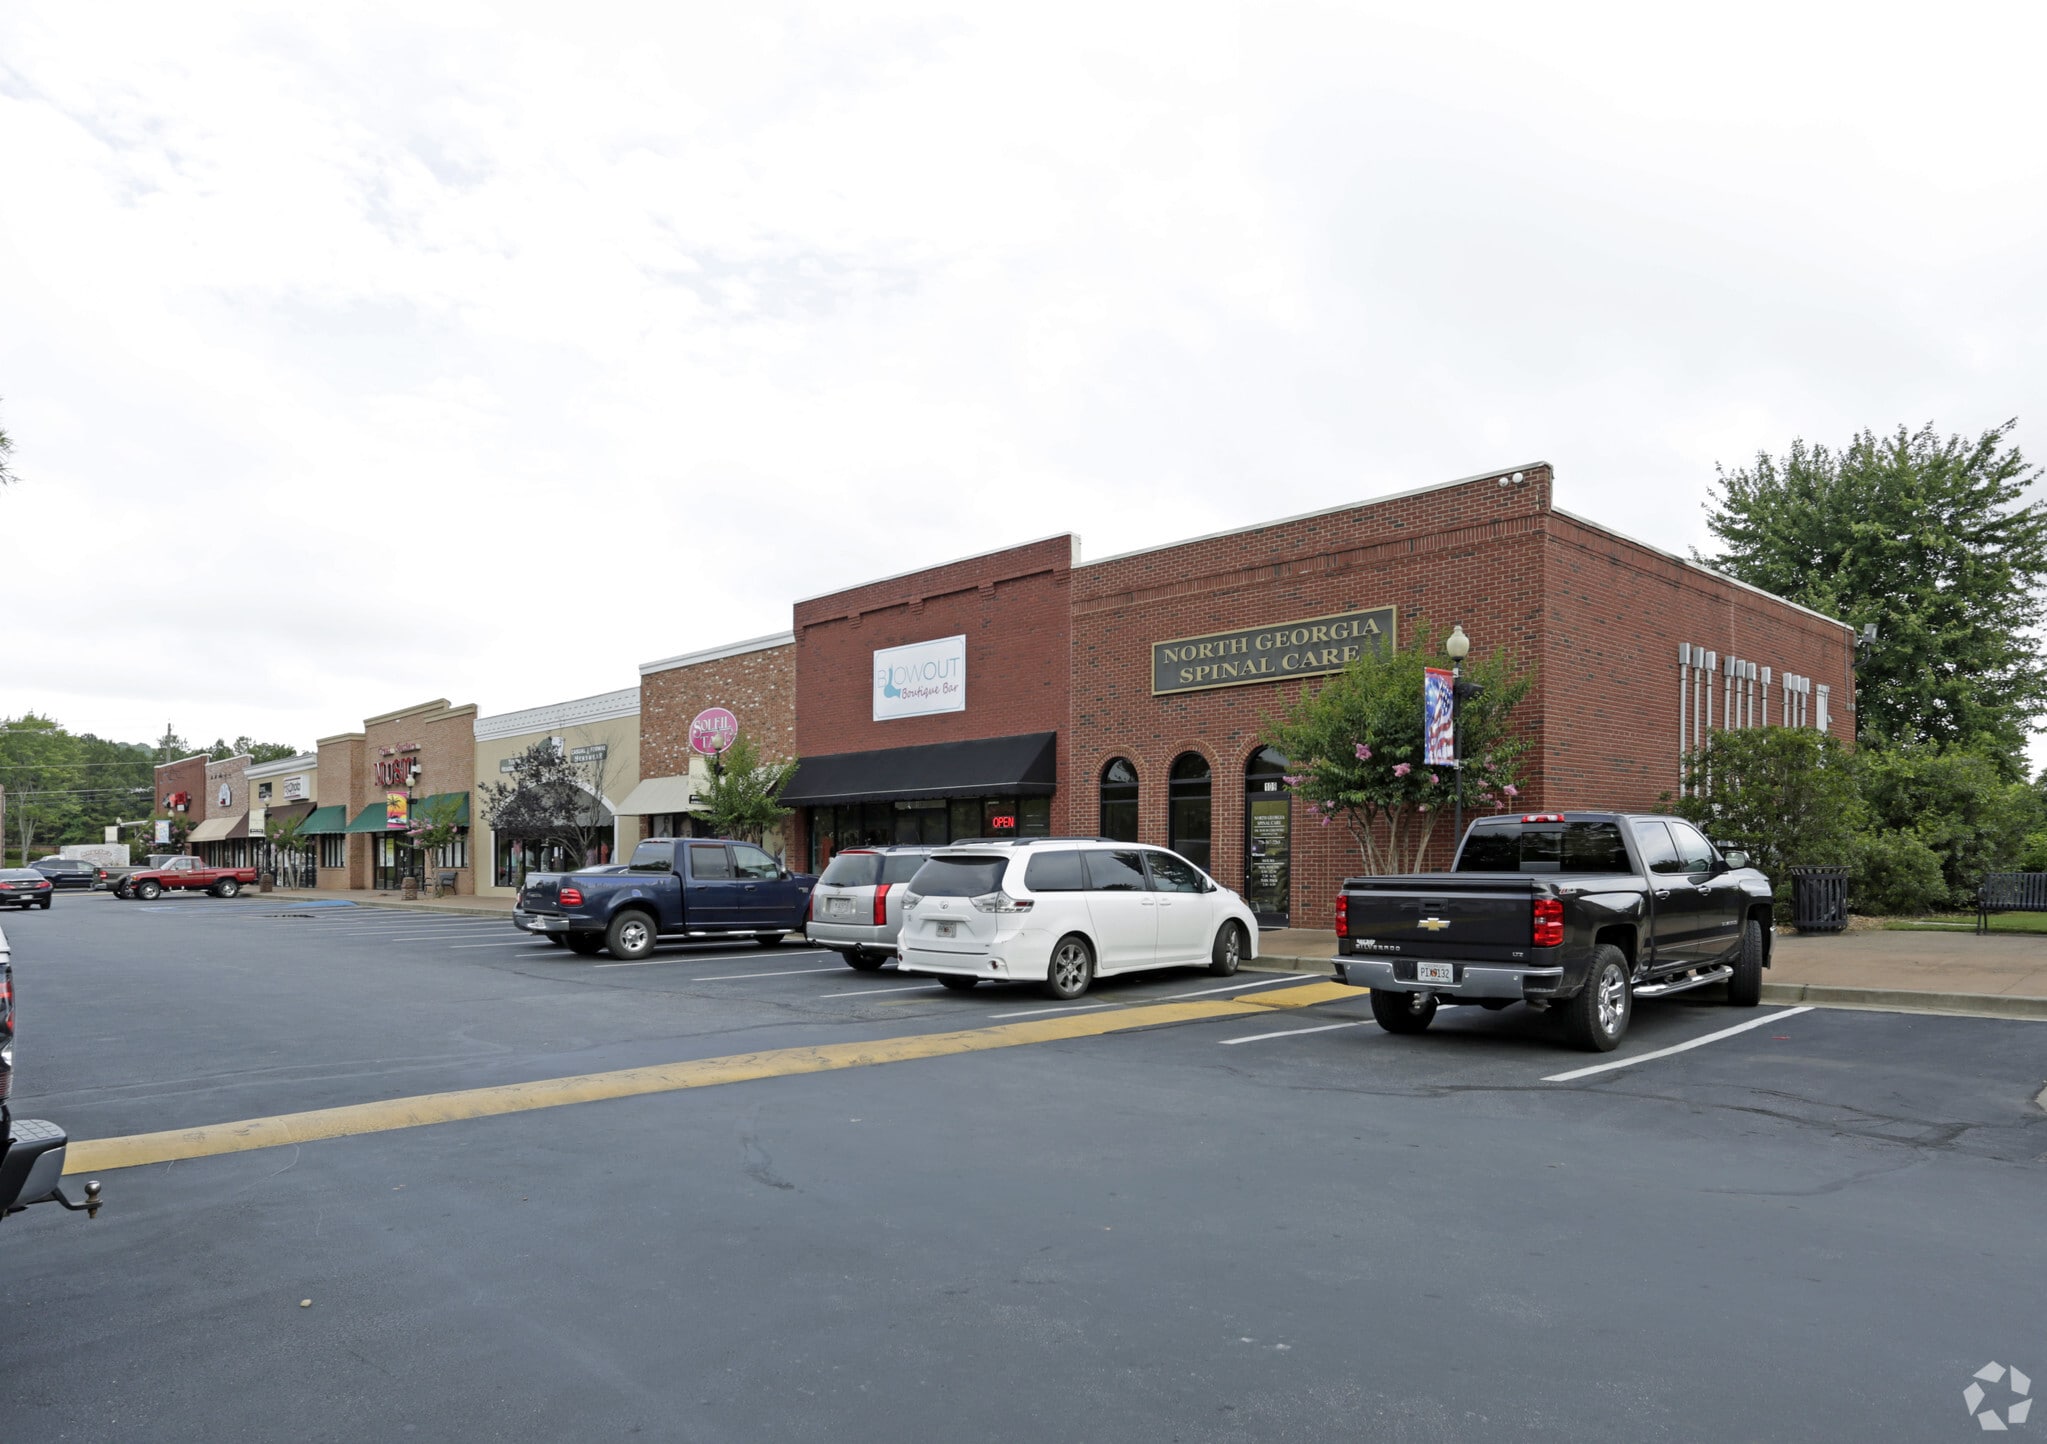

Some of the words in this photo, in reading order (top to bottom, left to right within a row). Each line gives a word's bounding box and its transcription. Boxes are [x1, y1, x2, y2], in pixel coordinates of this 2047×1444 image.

[1163, 636, 1249, 664] NORTH
[1255, 617, 1381, 650] GEORGIA
[1179, 656, 1276, 684] SPINAL
[1281, 644, 1361, 671] CARE
[901, 685, 940, 700] Boutique
[942, 681, 959, 694] Bar
[692, 716, 731, 738] SOLEIL
[992, 816, 1015, 828] OPEN
[1355, 943, 1400, 951] SILVERADO
